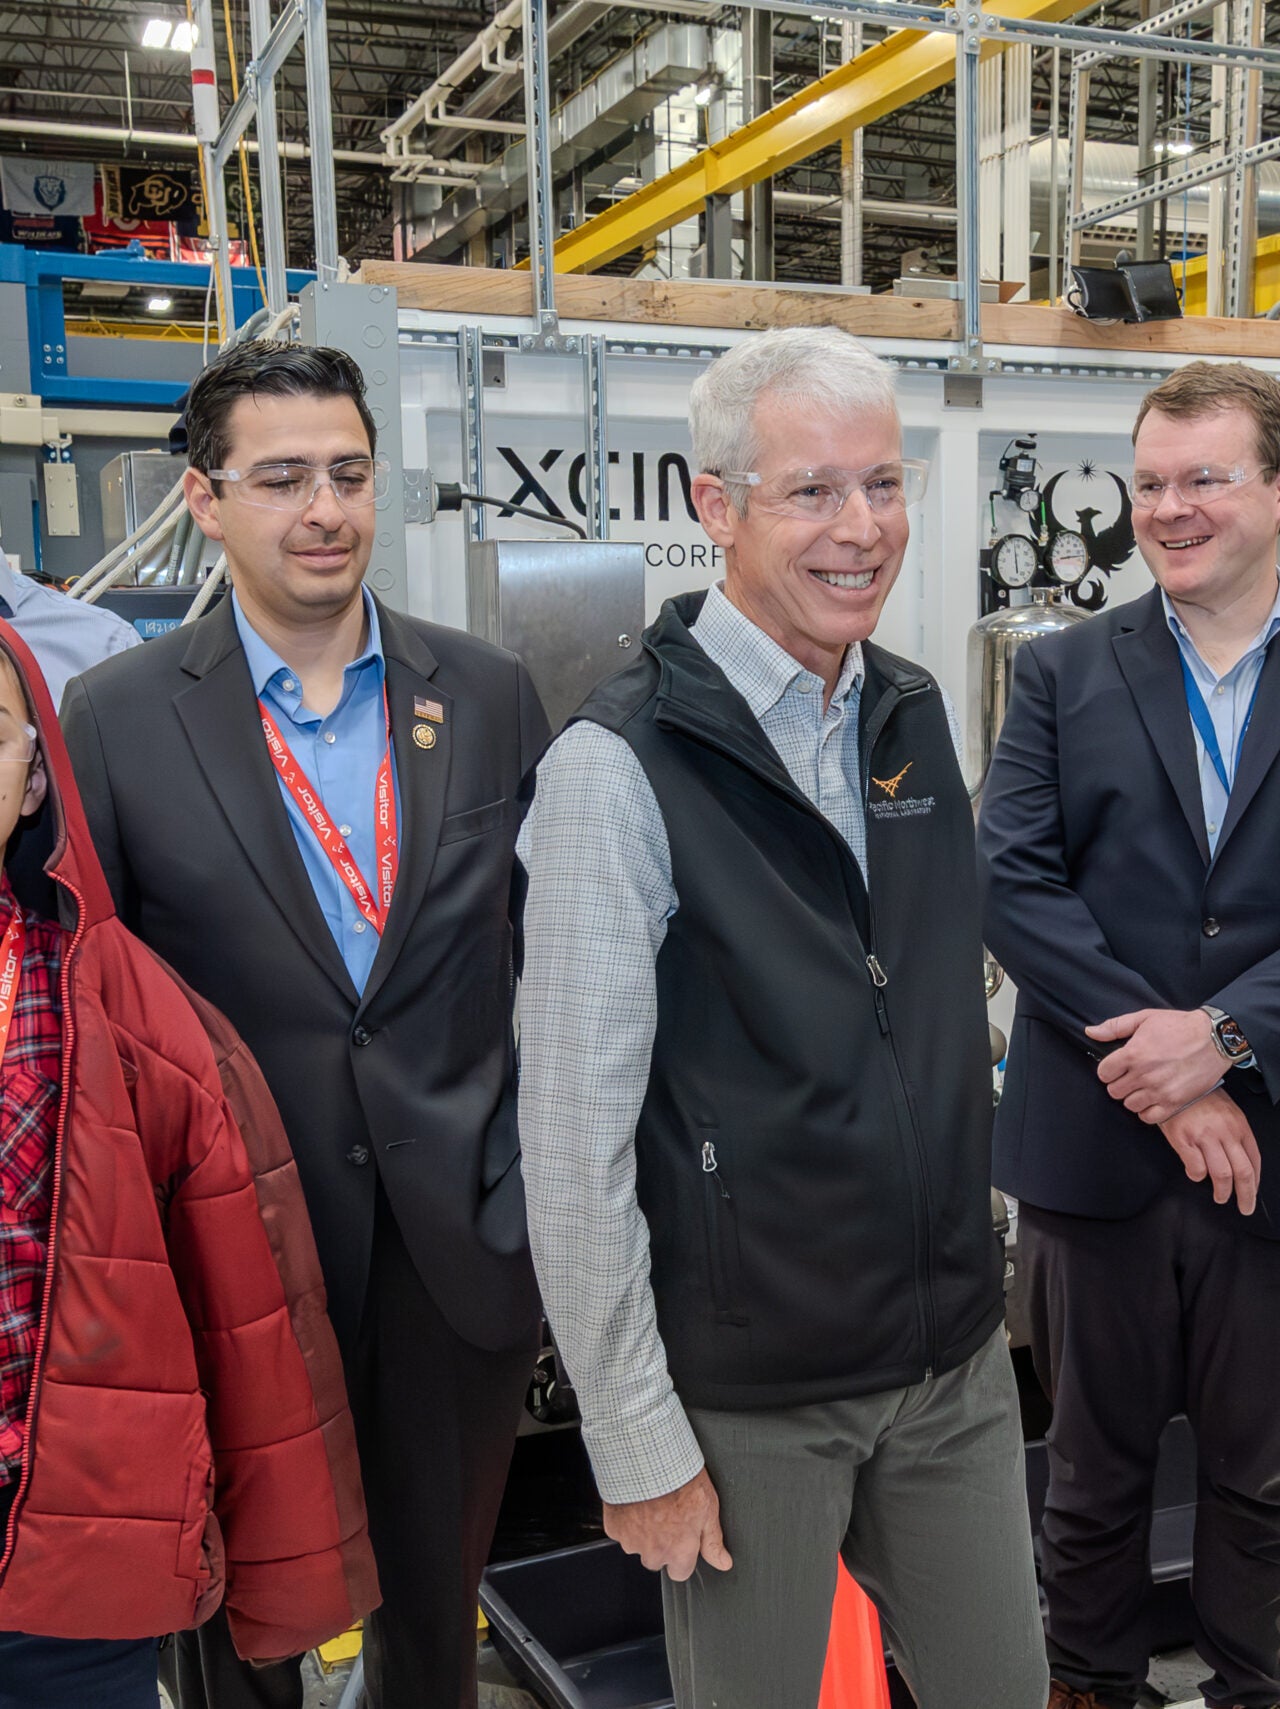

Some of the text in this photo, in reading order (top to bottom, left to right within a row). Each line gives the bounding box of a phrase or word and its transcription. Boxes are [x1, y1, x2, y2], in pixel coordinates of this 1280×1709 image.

[297, 786, 332, 840] Visitor
[379, 771, 390, 830] Visitor
[340, 859, 371, 913] Visitor
